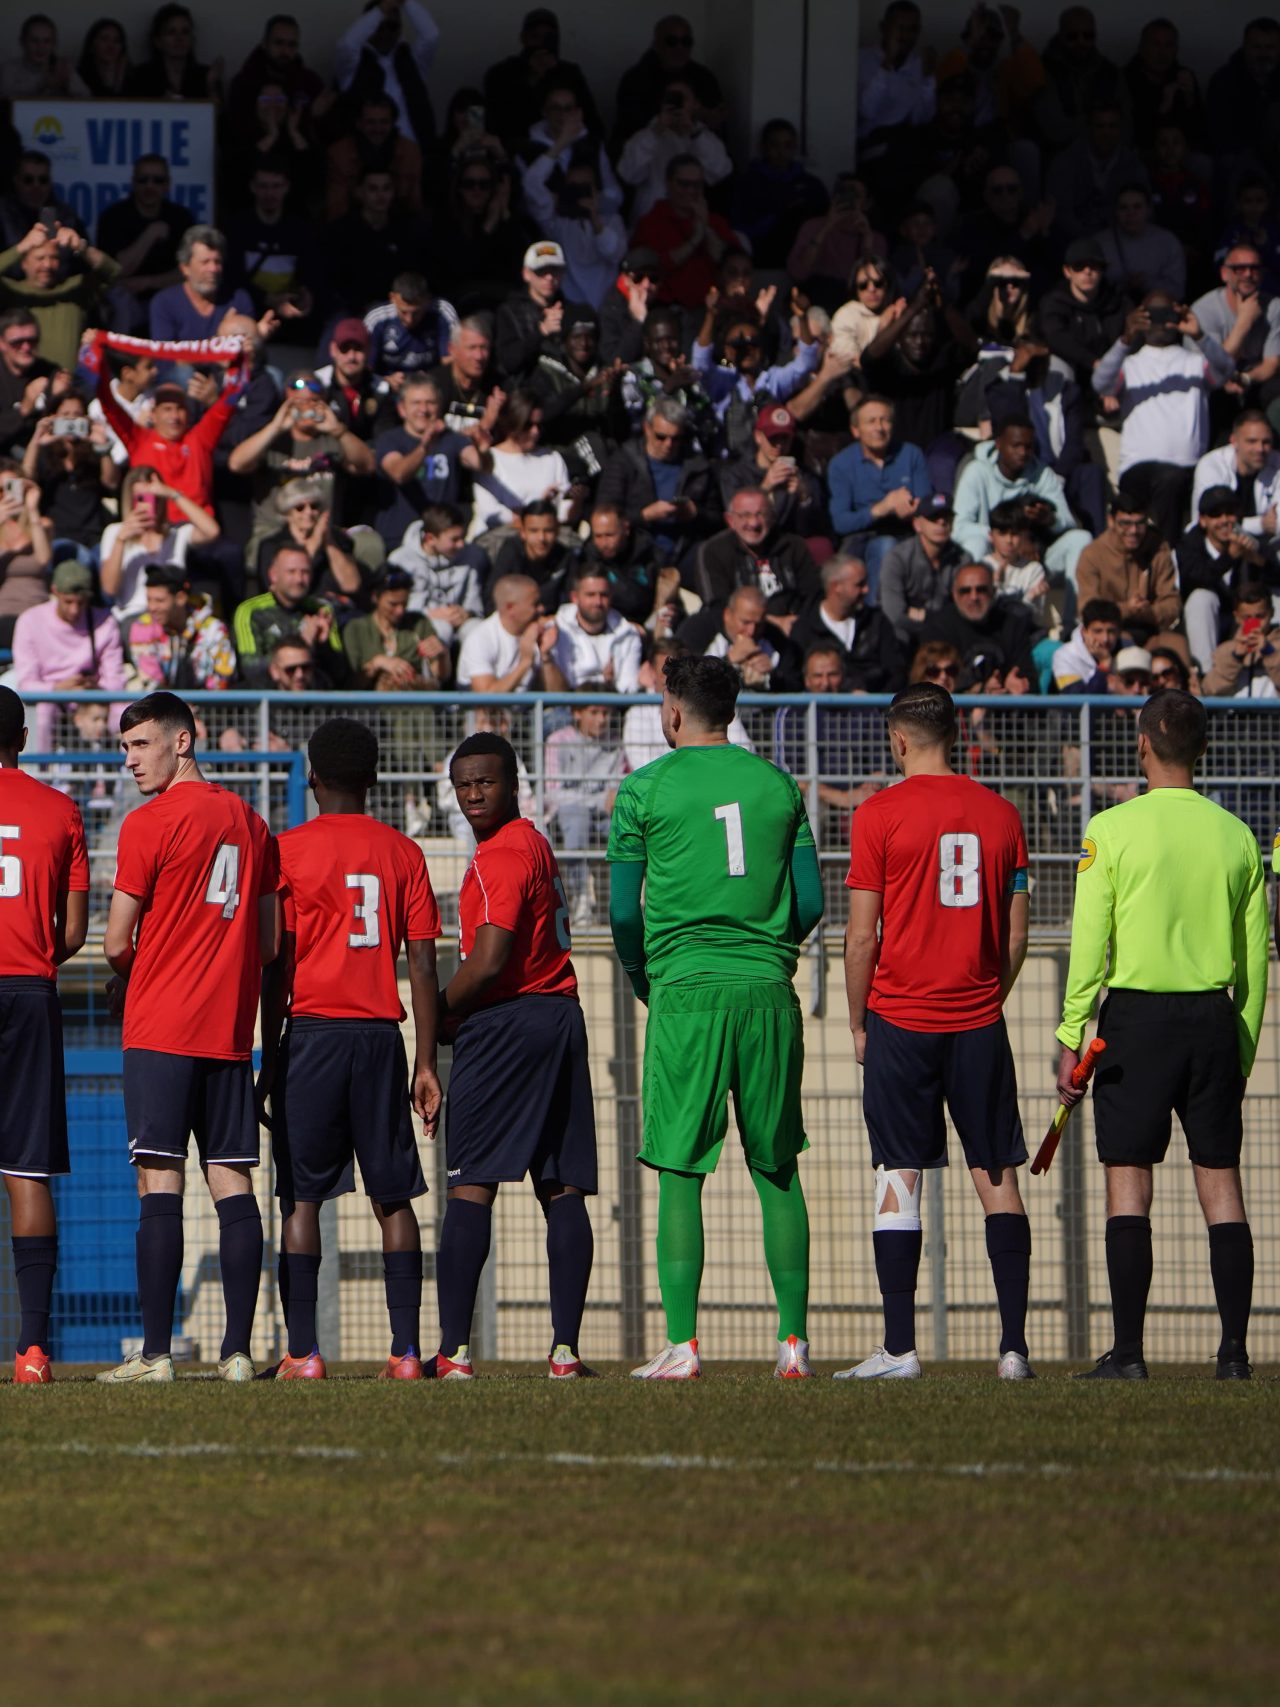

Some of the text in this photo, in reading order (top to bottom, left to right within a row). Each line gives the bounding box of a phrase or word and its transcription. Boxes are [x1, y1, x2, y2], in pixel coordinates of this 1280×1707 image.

[86, 118, 190, 166] VILLE
[712, 799, 747, 878] 1
[938, 832, 982, 909] 8
[205, 843, 241, 920] 4
[344, 872, 382, 949] 3
